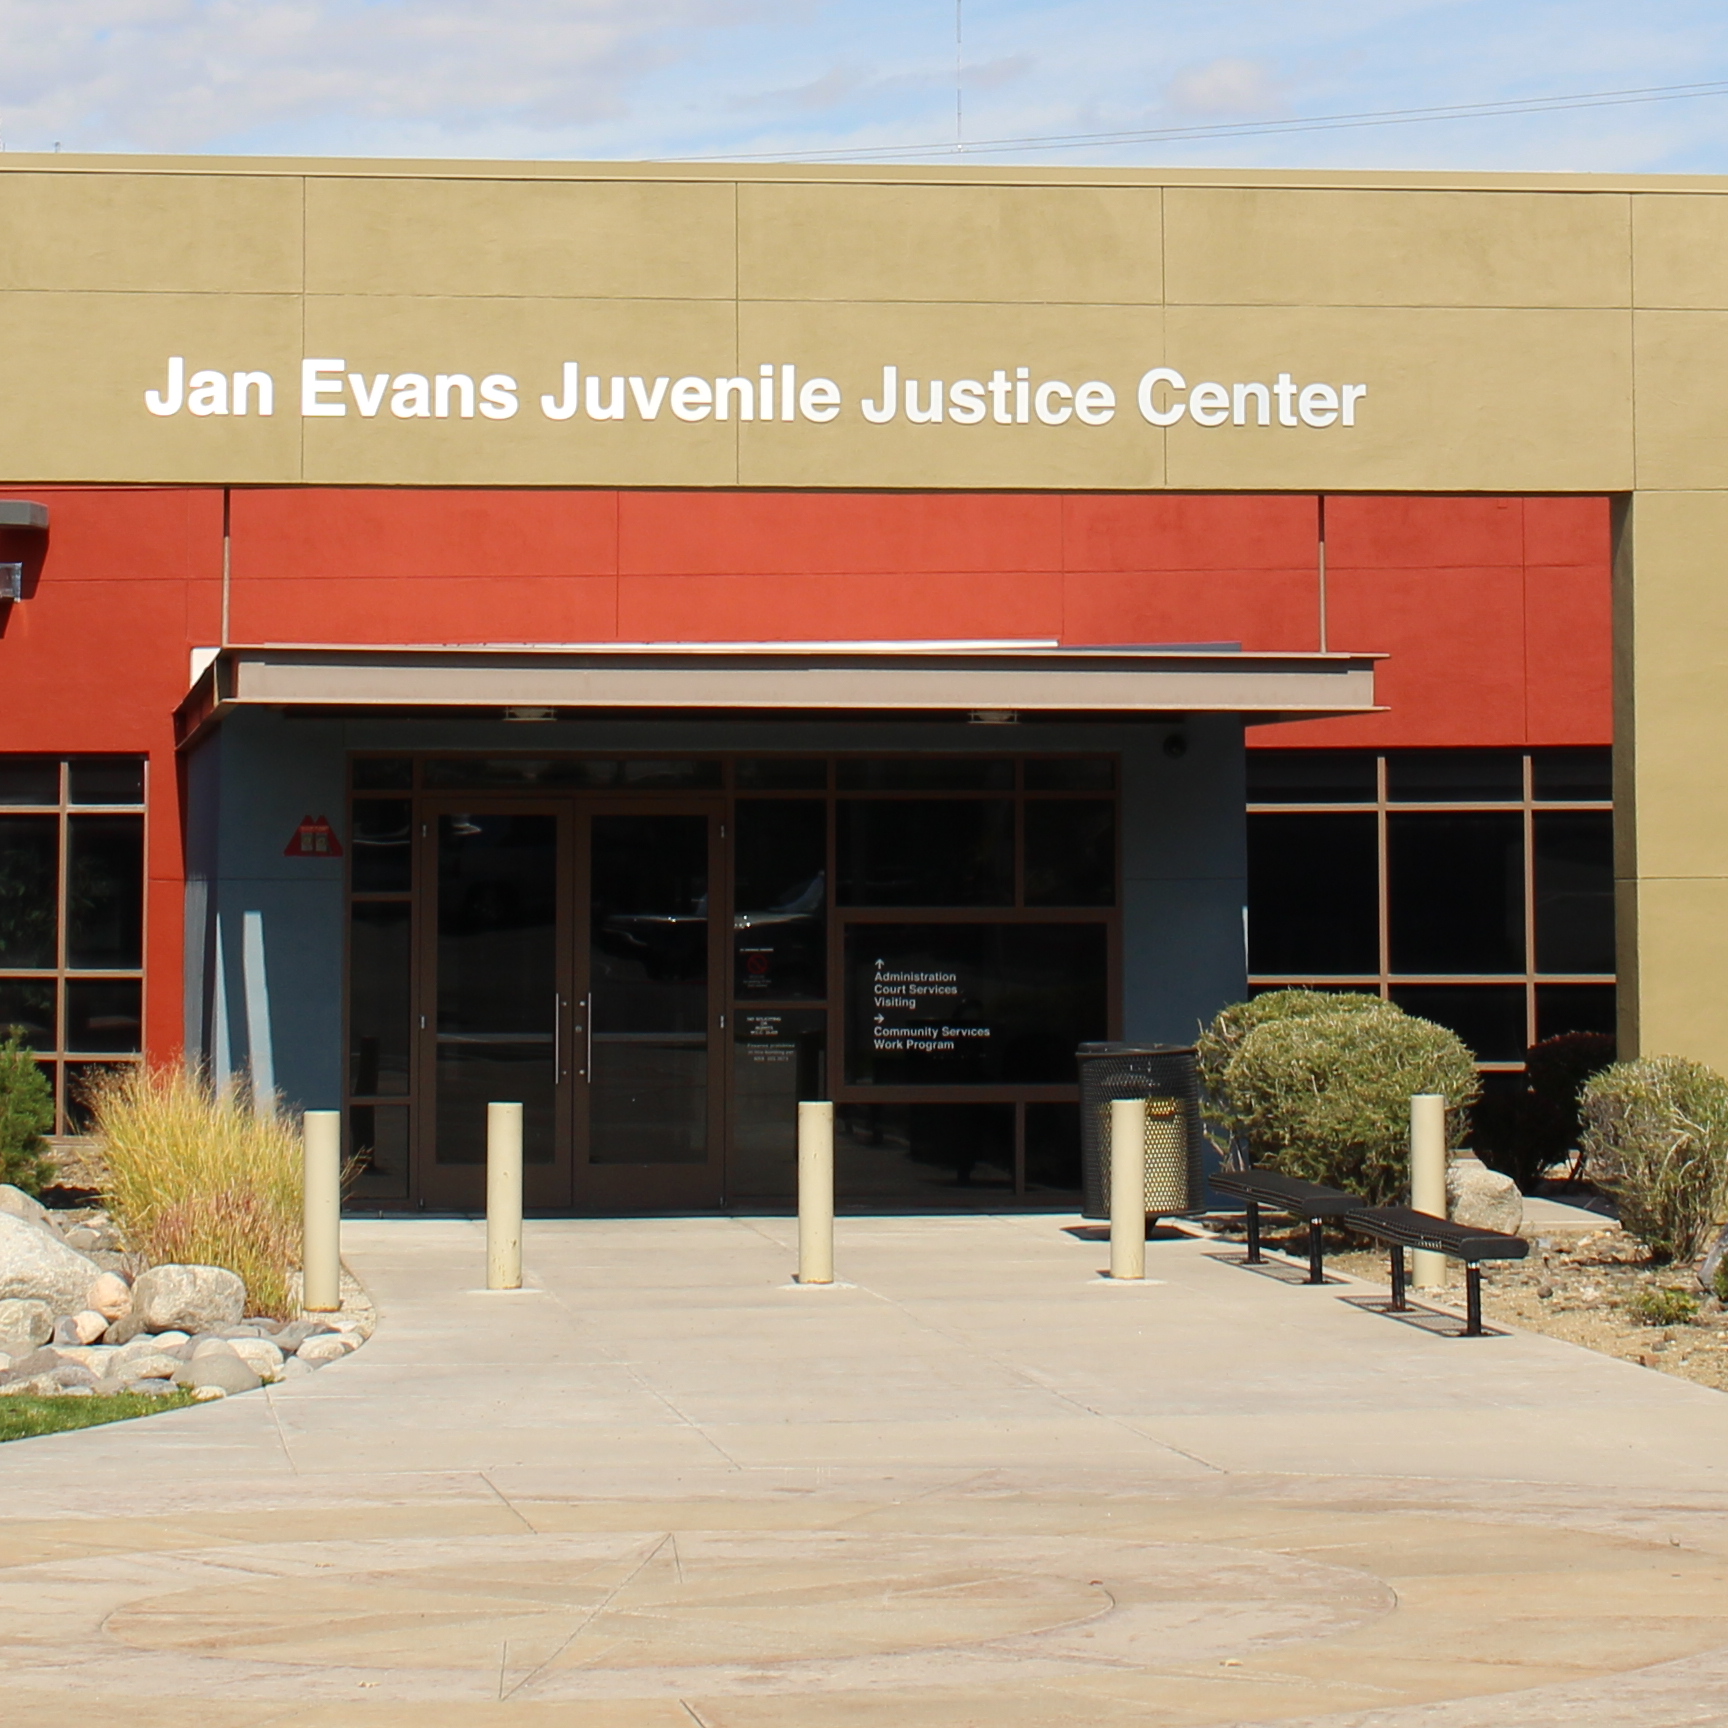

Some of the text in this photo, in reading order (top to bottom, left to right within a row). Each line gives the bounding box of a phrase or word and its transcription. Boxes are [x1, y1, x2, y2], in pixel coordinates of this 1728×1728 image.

[144, 355, 1368, 428] Jan Evans Juvenile Justice Center
[874, 971, 957, 982] Administration
[874, 984, 958, 994] Court Services
[874, 996, 916, 1009] Visiting
[873, 1026, 991, 1039] Community Services
[873, 1039, 955, 1052] Work Program
